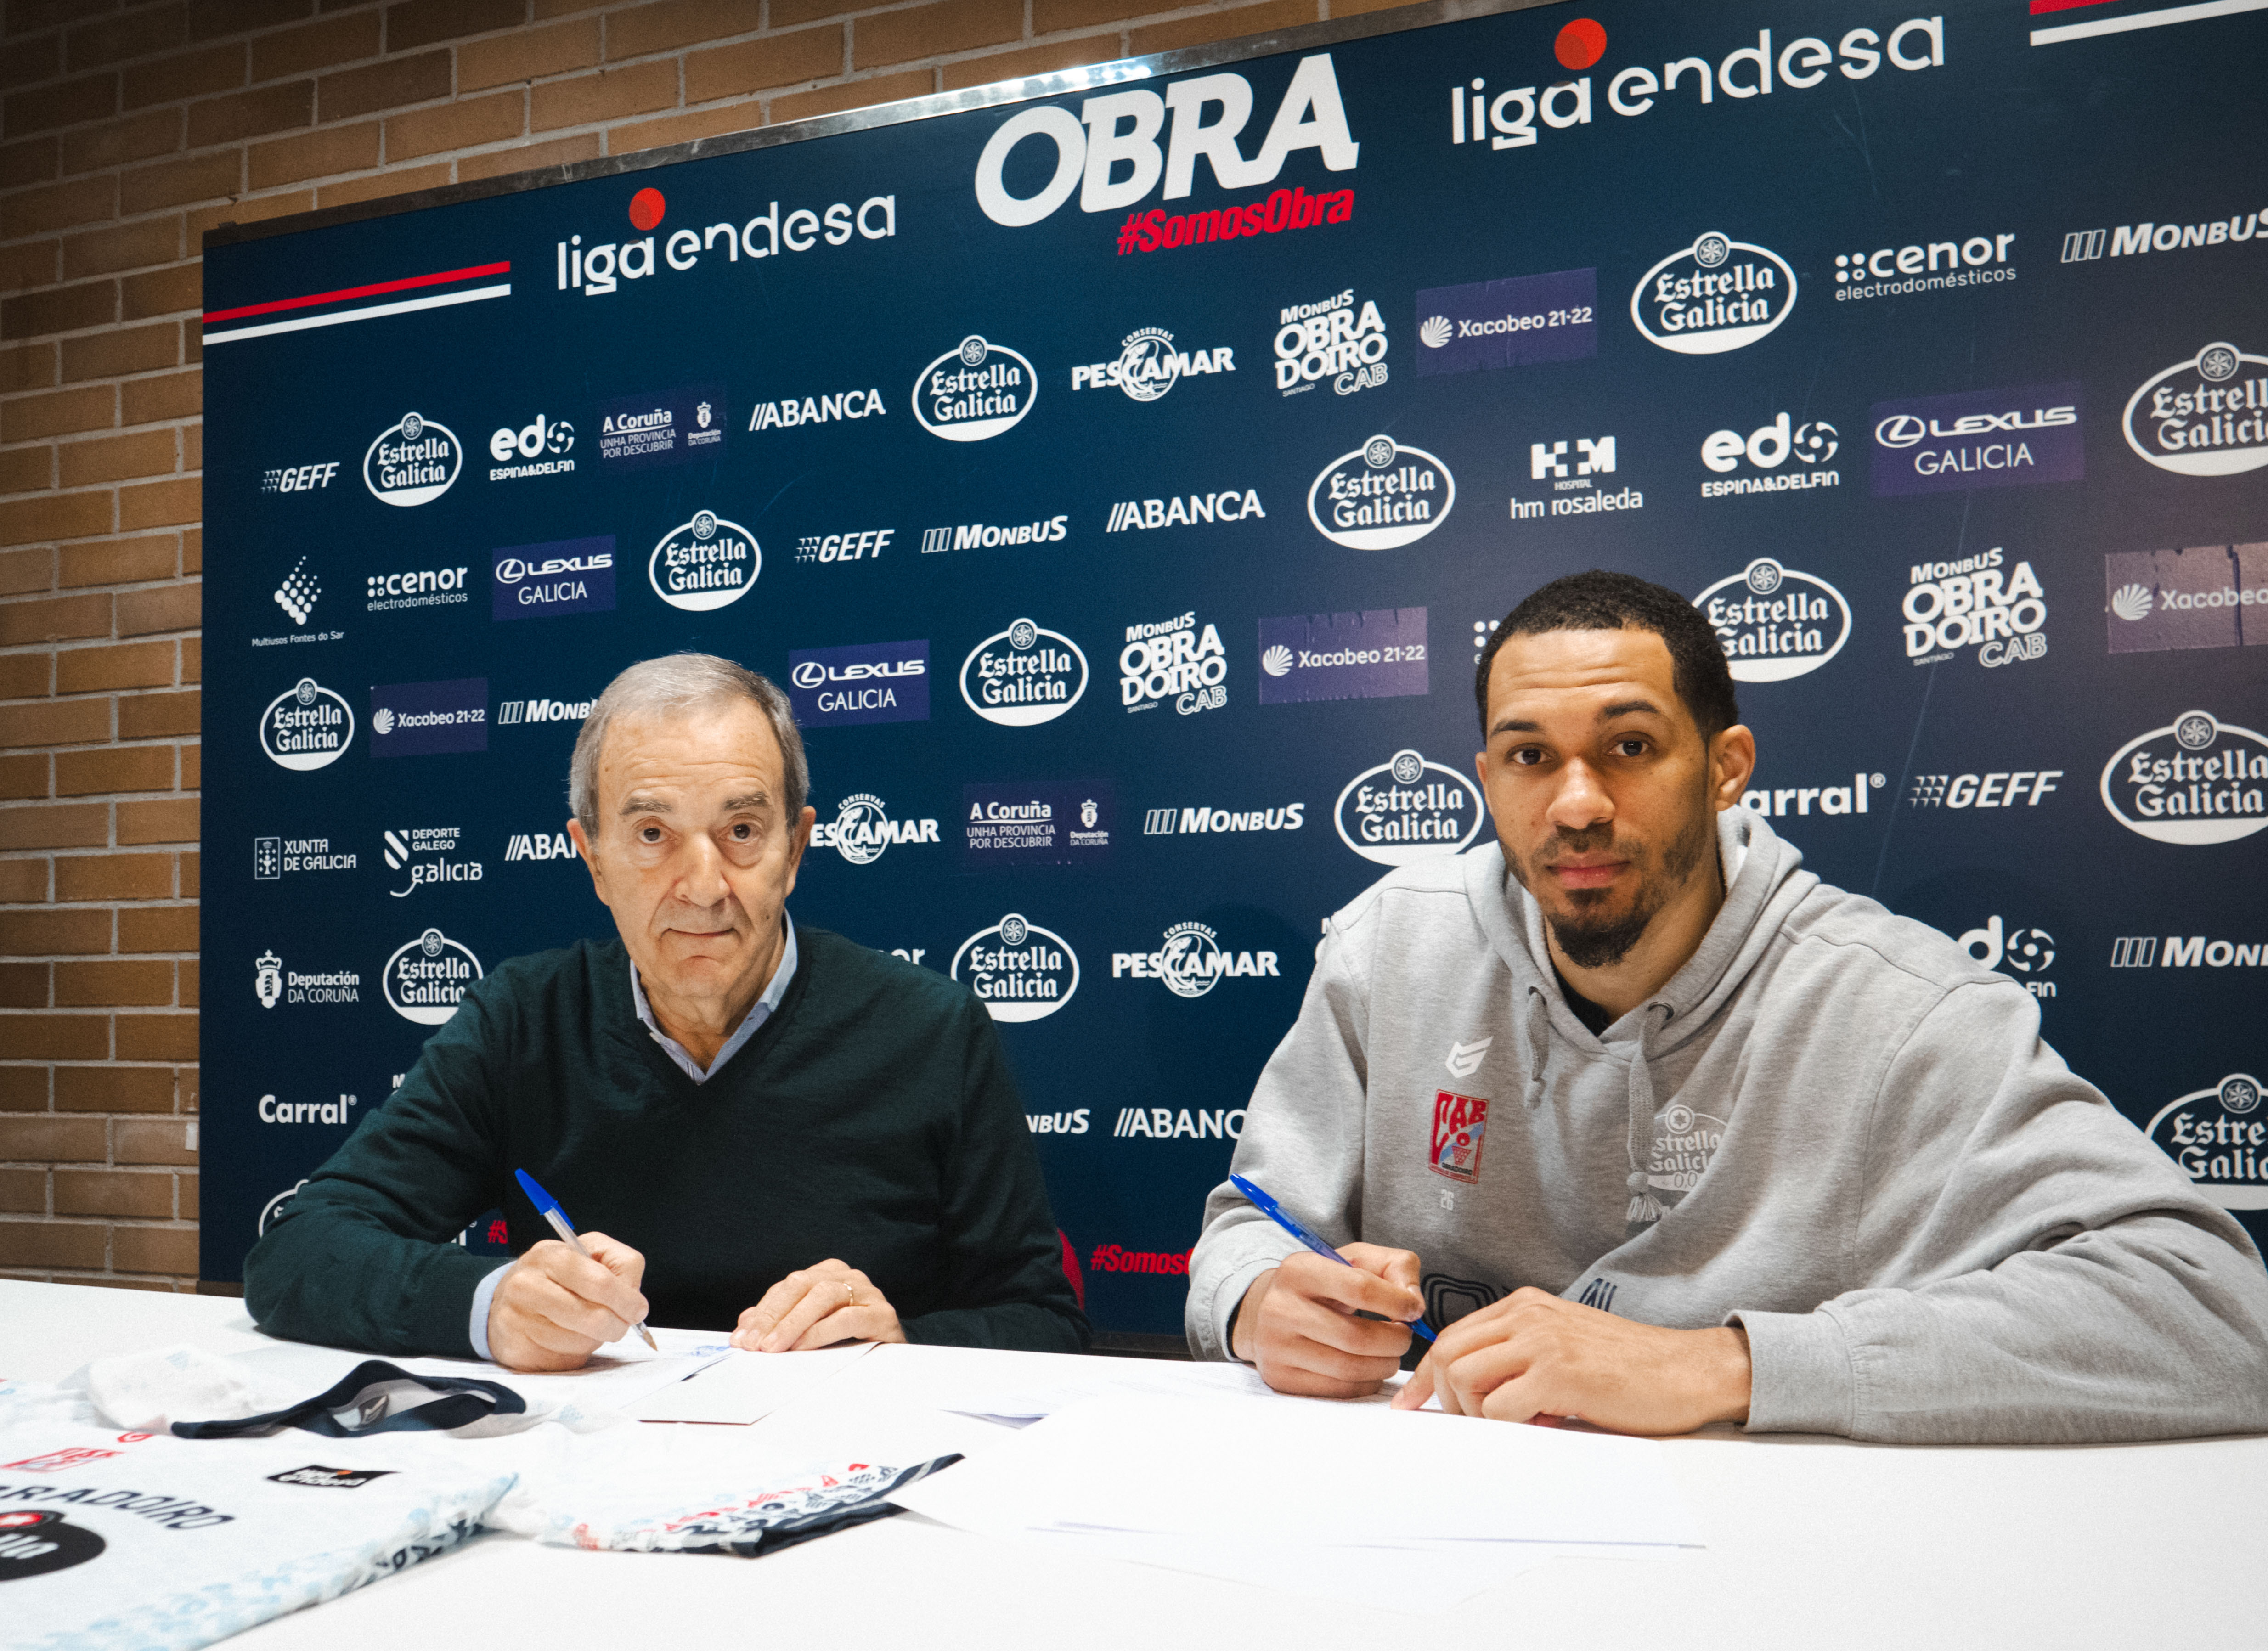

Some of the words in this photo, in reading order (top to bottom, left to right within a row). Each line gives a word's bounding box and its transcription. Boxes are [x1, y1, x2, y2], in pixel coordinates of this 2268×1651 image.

[1452, 77, 1591, 151] liga
[1608, 16, 1944, 116] endesa
[975, 52, 1360, 227] OBRA
[1117, 187, 1354, 255] #SomosObra
[558, 235, 655, 296] liga
[666, 195, 896, 270] endesa
[1868, 233, 2016, 280] cenor
[1654, 263, 1775, 304] Estrella
[1835, 267, 2016, 301] electrodomésticos
[1281, 289, 1354, 325] MONBUS
[1660, 293, 1770, 332] Galicia
[1122, 327, 1173, 347] CONSERVAS
[1274, 300, 1385, 359] OBRA
[1458, 314, 1546, 338] Xacobeo
[1072, 347, 1236, 390] PESCAMAR
[1275, 333, 1388, 390] DOIRO
[930, 363, 1021, 398] Estrella
[1283, 383, 1315, 397] SANTIAGO
[1334, 362, 1388, 395] CAB
[934, 394, 1017, 421] Galicia
[2150, 378, 2268, 421] Estrell
[603, 416, 615, 433] A
[617, 409, 672, 431] Coruña
[1929, 406, 2077, 437] LEXUS
[2158, 410, 2268, 451] Galici
[377, 437, 450, 468] Estrella
[600, 436, 626, 449] UNHA
[628, 428, 676, 444] PROVINCIA
[603, 447, 621, 458] POR
[623, 439, 673, 456] DESCUBRIR
[381, 460, 446, 488] Galicia
[1914, 442, 2034, 475] GALICIA
[279, 462, 340, 493] GEFF
[1328, 466, 1436, 503] Estrella
[1554, 479, 1593, 490] HOSPITAL
[1333, 496, 1431, 528] Galicia
[1510, 497, 1545, 519] hm
[1551, 487, 1643, 516] rosaleda
[818, 529, 895, 563] GEFF
[953, 515, 1068, 550] MONBUS
[527, 553, 613, 576] LEXUS
[665, 538, 747, 568] Estrella
[1910, 547, 2003, 584] MONBUS
[386, 567, 468, 595] cenor
[668, 563, 743, 591] Galicia
[367, 593, 468, 611] electrodomésticos
[518, 581, 588, 605] GALICIA
[1902, 562, 2043, 624] OBRA
[1707, 592, 1829, 627] Estrella
[252, 637, 288, 647] Multiusos
[290, 634, 316, 643] Fontes
[317, 632, 328, 641] do
[330, 631, 345, 640] Sar
[1126, 611, 1196, 642] MONBUS
[1715, 622, 1823, 657] Galicia
[1904, 598, 2047, 657] DOIRO
[978, 648, 1072, 681] Estrella
[1120, 624, 1225, 677] OBRA
[1298, 648, 1381, 668] Xacobeo
[1914, 652, 1954, 666] SANTIAGO
[1979, 632, 2048, 668] CAB
[828, 659, 925, 681] LEXUS
[1120, 656, 1227, 706] DOIRO
[818, 688, 897, 712] GALICIA
[982, 676, 1067, 704] Galicia
[1128, 701, 1158, 713] SANTIAGO
[1176, 685, 1228, 716] CAB
[273, 704, 342, 732] Estrella
[398, 711, 455, 727] Xacobeo
[525, 700, 593, 723] MONB
[276, 726, 339, 752] Galicia
[2128, 749, 2268, 784] Estrella
[838, 794, 885, 809] CONSERVAS
[1355, 783, 1464, 813] Estrella
[1946, 770, 2064, 809] GEFF
[2135, 781, 2264, 817] Galicia
[970, 802, 983, 820] A
[987, 801, 1052, 818] Coruña
[1179, 802, 1305, 834] MONBUS
[412, 827, 461, 840] DEPORTE
[810, 818, 940, 847] ESCAMAR
[967, 826, 997, 838] UNHA
[999, 824, 1056, 836] PROVINCIA
[1360, 811, 1459, 842] Galicia
[284, 839, 328, 854] XUNTA
[412, 840, 456, 851] GALEGO
[970, 838, 992, 849] POR
[993, 836, 1052, 848] DESCUBRIR
[284, 856, 300, 871] DE
[302, 854, 356, 870] GALICIA
[411, 857, 483, 885] galicia
[1163, 921, 1217, 939] CONSERVAS
[397, 957, 470, 980] Estrella
[969, 946, 1062, 972] Estrella
[1112, 951, 1280, 979] PESCAMAR
[288, 970, 360, 990] Deputación
[288, 989, 305, 1003] DA
[308, 986, 359, 1003] CORUÑA
[973, 972, 1058, 998] Galicia
[1026, 1109, 1090, 1134] NBUS
[1128, 1108, 1247, 1139] ABANC
[2171, 1112, 2268, 1145] Estre
